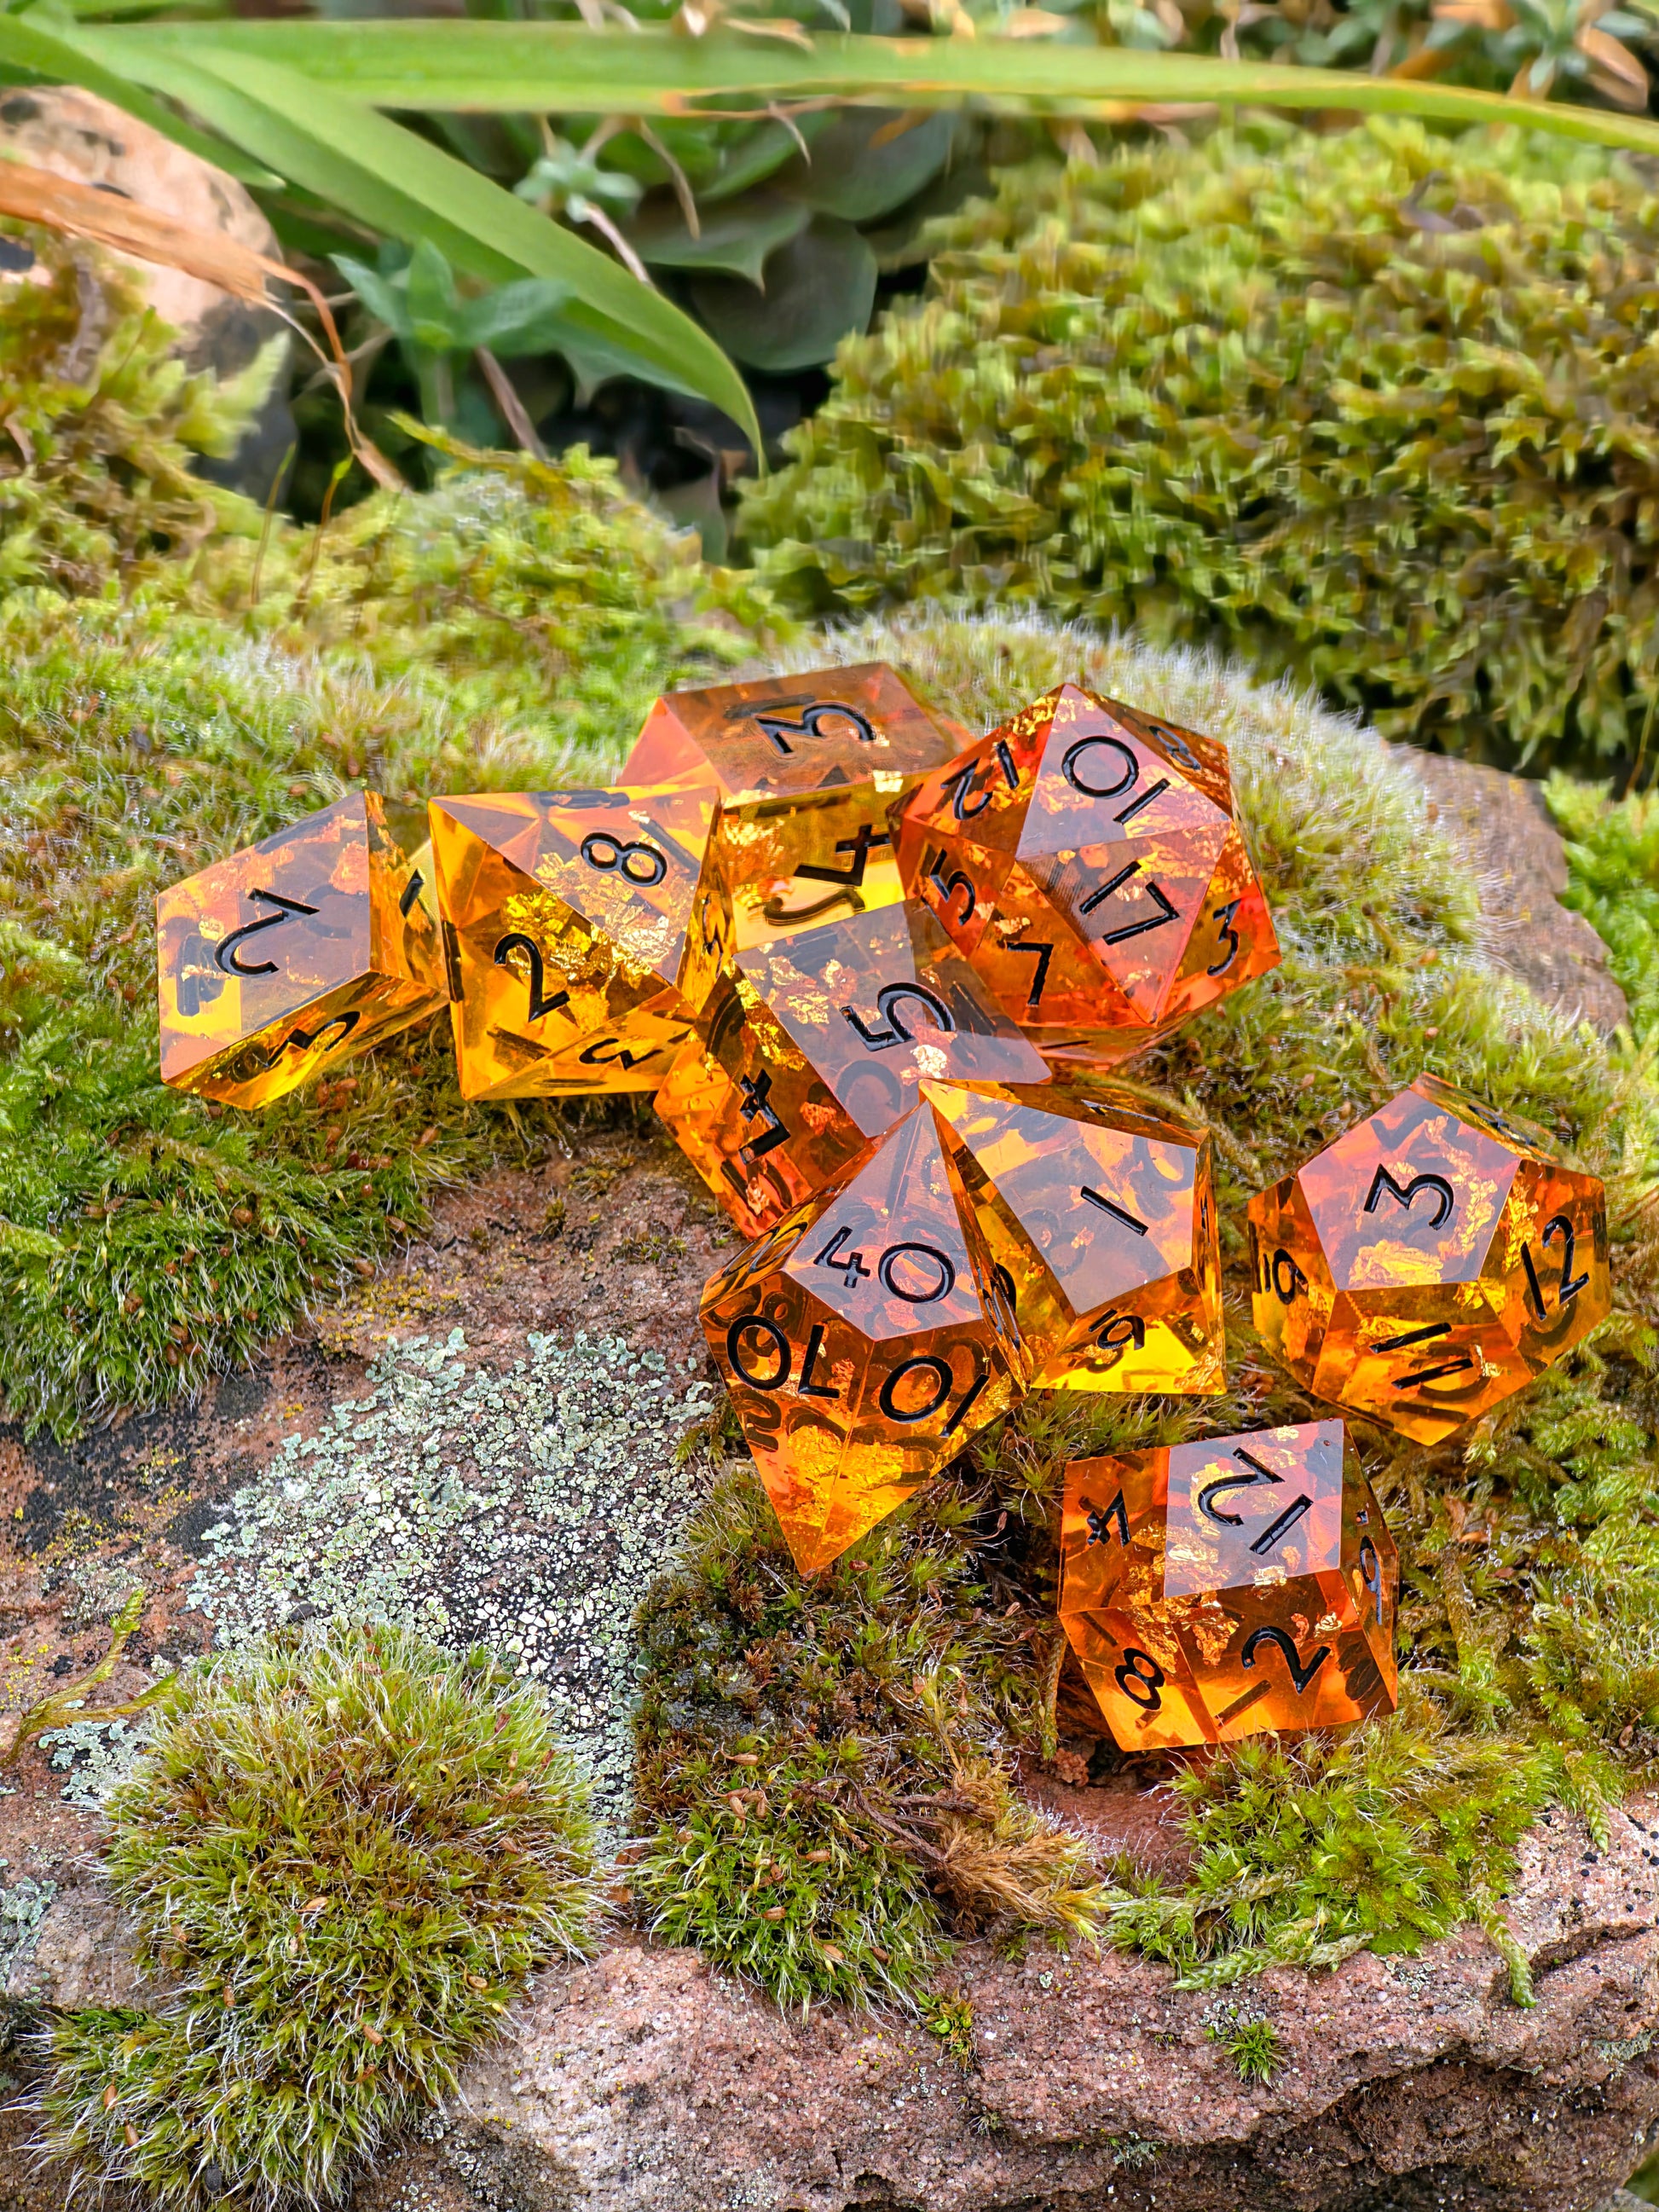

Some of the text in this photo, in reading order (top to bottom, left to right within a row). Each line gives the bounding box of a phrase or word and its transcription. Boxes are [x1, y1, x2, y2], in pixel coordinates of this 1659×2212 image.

[754, 700, 877, 755] 3
[1061, 736, 1171, 825] 10
[581, 832, 668, 888] 8
[214, 888, 321, 976] 2
[1079, 860, 1180, 946] 17
[1207, 900, 1240, 976] 3
[493, 932, 570, 1022] 2
[1007, 942, 1054, 1006] 7
[839, 982, 956, 1051] 5
[1364, 1163, 1454, 1230] 3
[813, 1226, 956, 1303] 40
[1521, 1214, 1590, 1321] 12
[726, 1315, 840, 1399] 70
[879, 1356, 991, 1438] 10
[1086, 1488, 1132, 1548] 4
[1198, 1447, 1314, 1555] 12
[1114, 1647, 1165, 1711] 8
[1241, 1625, 1331, 1695] 2
